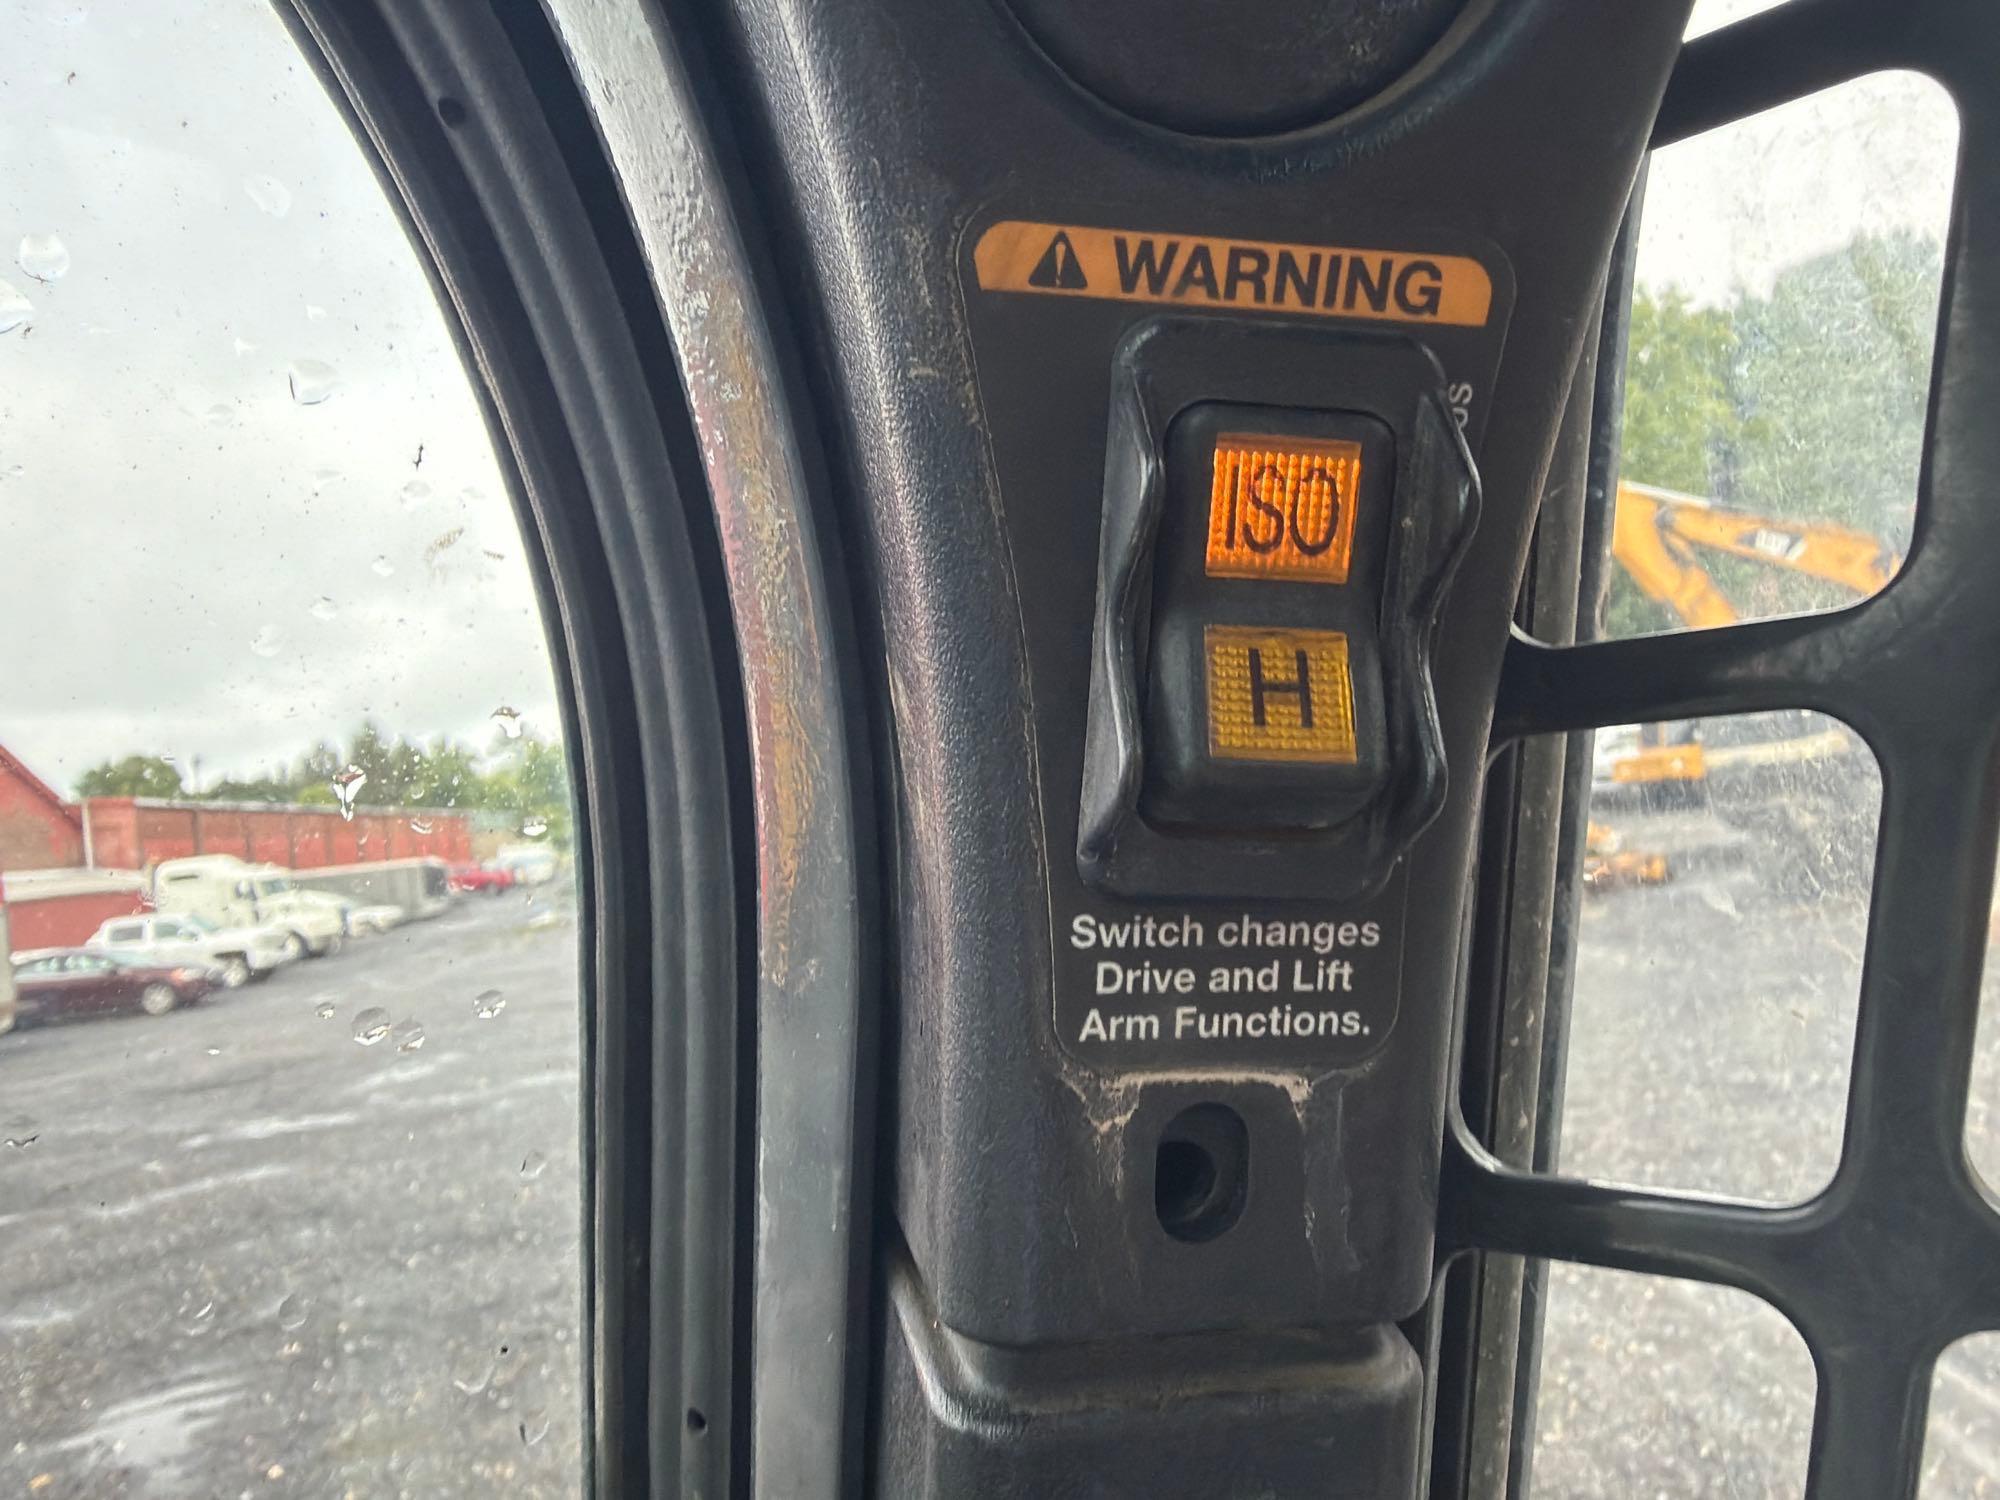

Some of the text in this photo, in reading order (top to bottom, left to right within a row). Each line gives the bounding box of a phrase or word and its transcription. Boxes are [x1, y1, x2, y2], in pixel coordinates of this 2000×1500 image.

[1113, 235, 1444, 317] WARNING
[1223, 462, 1340, 557] ISO
[1248, 647, 1313, 729] H
[1070, 914, 1381, 954] Switch changes
[1095, 959, 1354, 995] Drive and Lift
[1078, 1003, 1371, 1042] Arm Functions.
